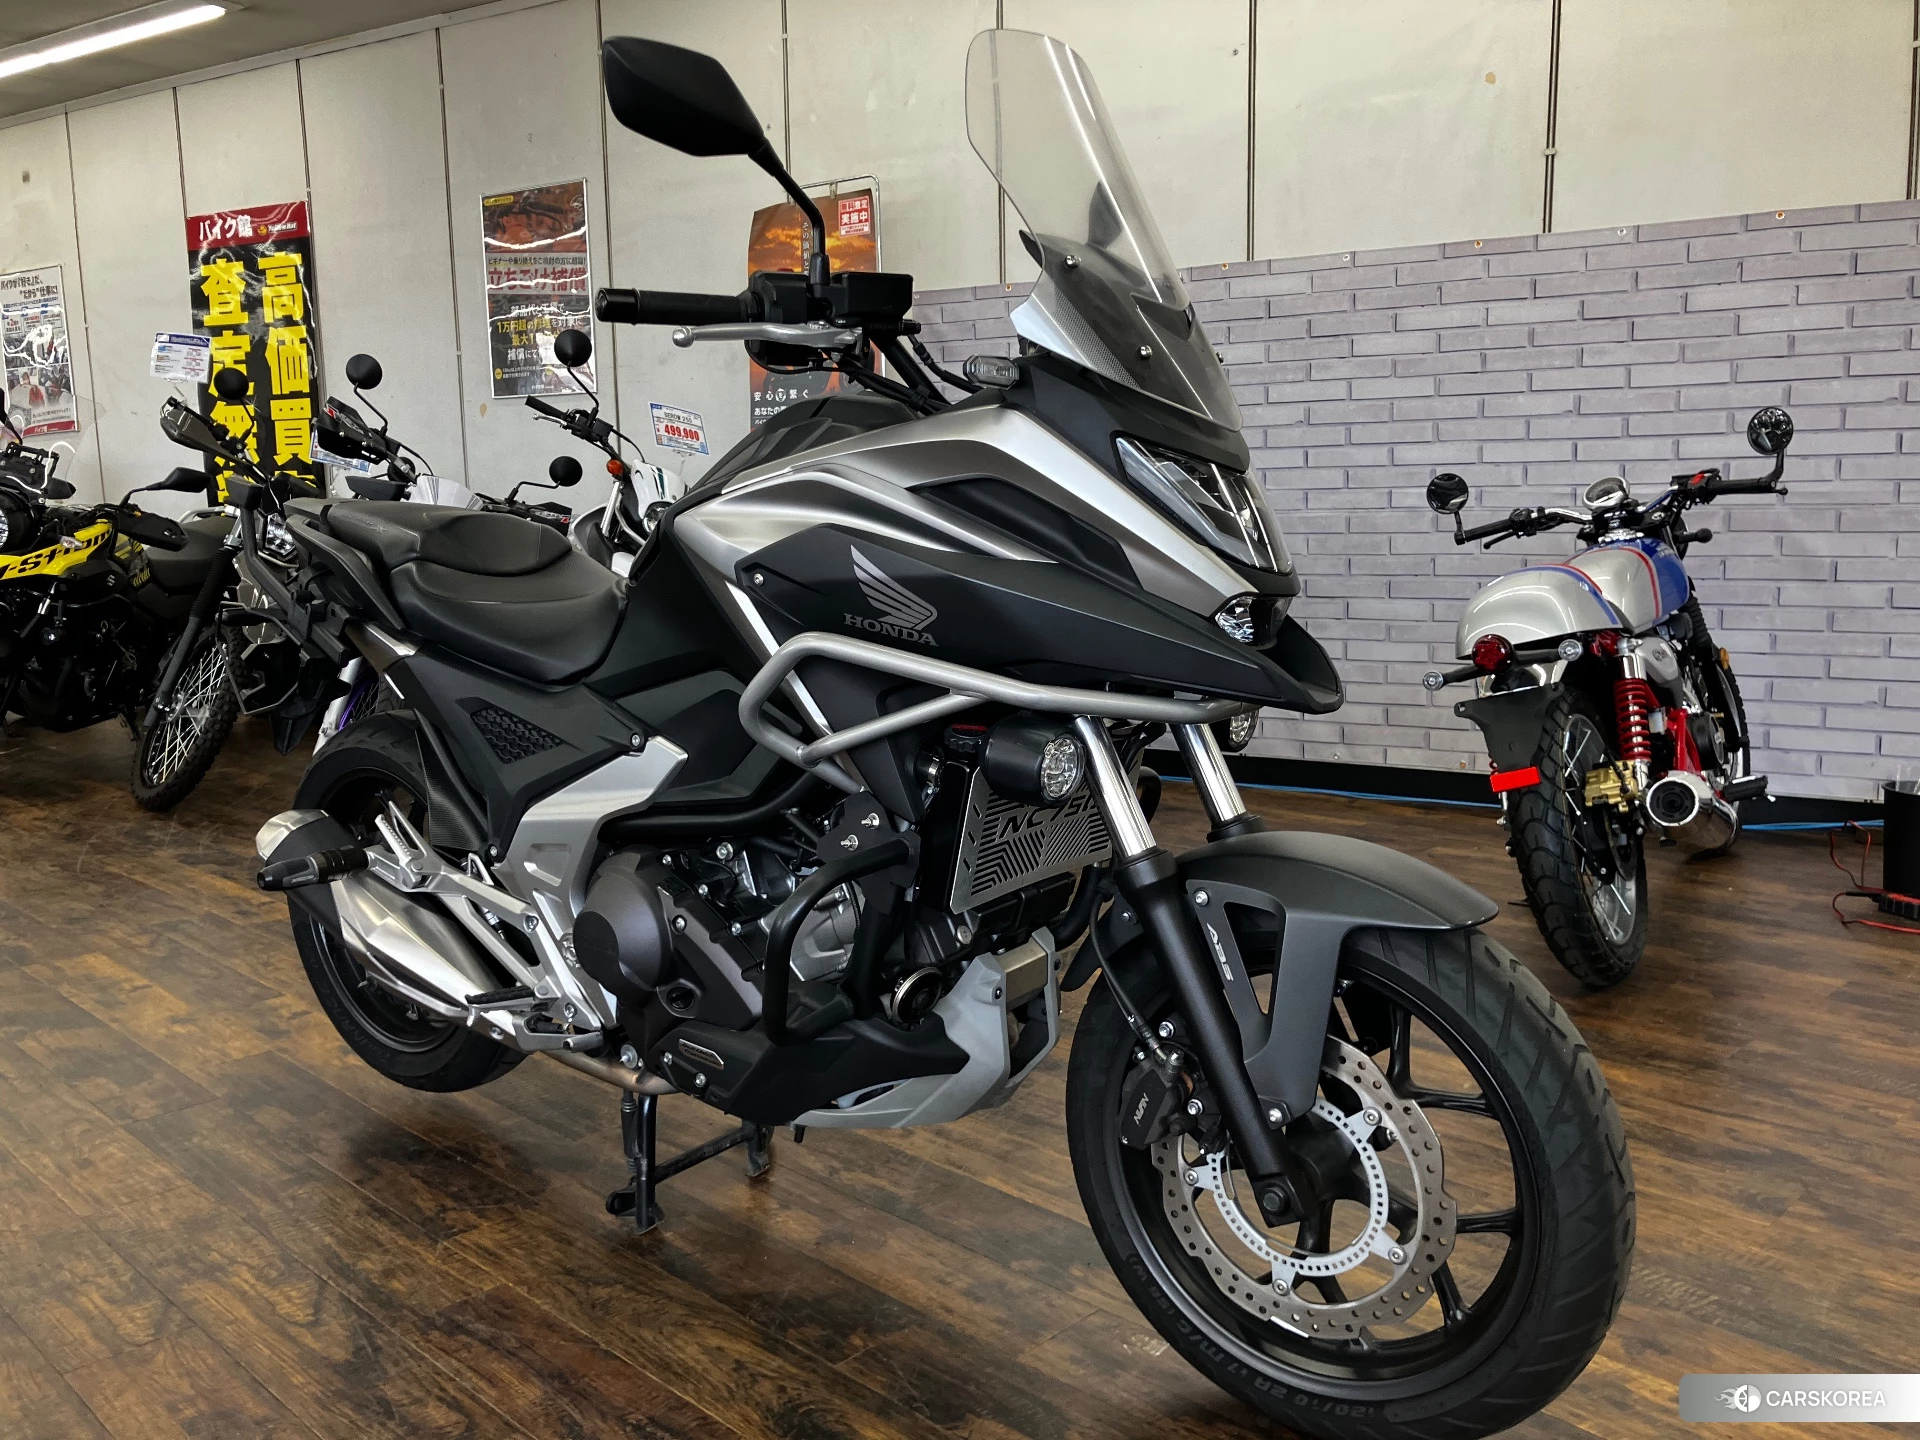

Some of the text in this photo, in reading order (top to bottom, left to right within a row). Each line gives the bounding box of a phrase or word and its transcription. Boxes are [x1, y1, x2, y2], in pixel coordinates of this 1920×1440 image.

[200, 215, 253, 241] バイク館
[841, 211, 868, 225] 実施中
[488, 267, 587, 292] 立ちごけ補償
[258, 252, 316, 488] 高価買
[844, 613, 938, 647] HONDA
[1206, 922, 1234, 981] ABS
